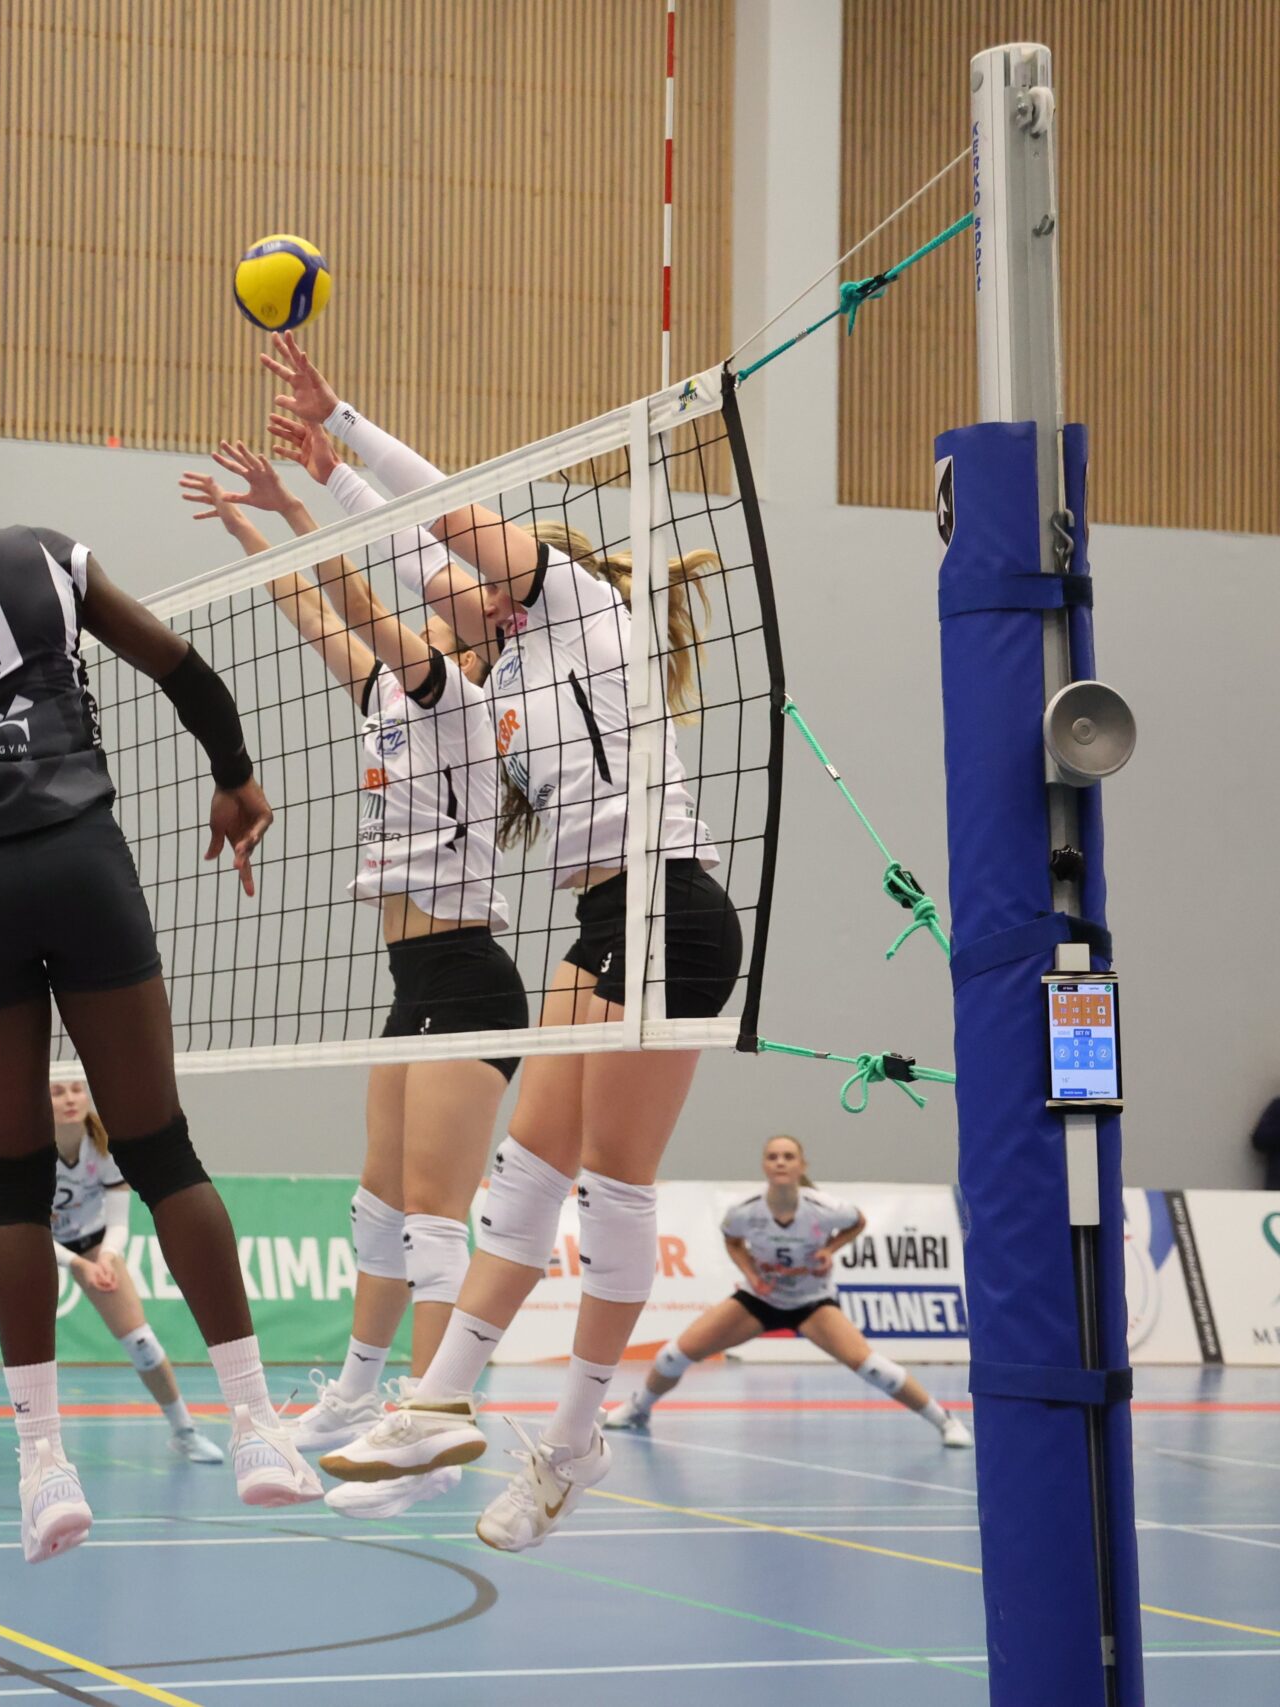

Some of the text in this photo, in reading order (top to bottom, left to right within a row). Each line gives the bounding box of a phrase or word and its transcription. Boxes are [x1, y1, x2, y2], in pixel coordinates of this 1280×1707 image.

[972, 120, 981, 207] KERKO
[1059, 1049, 1066, 1058] 2
[124, 1235, 358, 1301] KEKIMA
[775, 1247, 793, 1268] 5
[841, 1226, 949, 1269] JA VÄRI
[838, 1290, 960, 1333] UTANET
